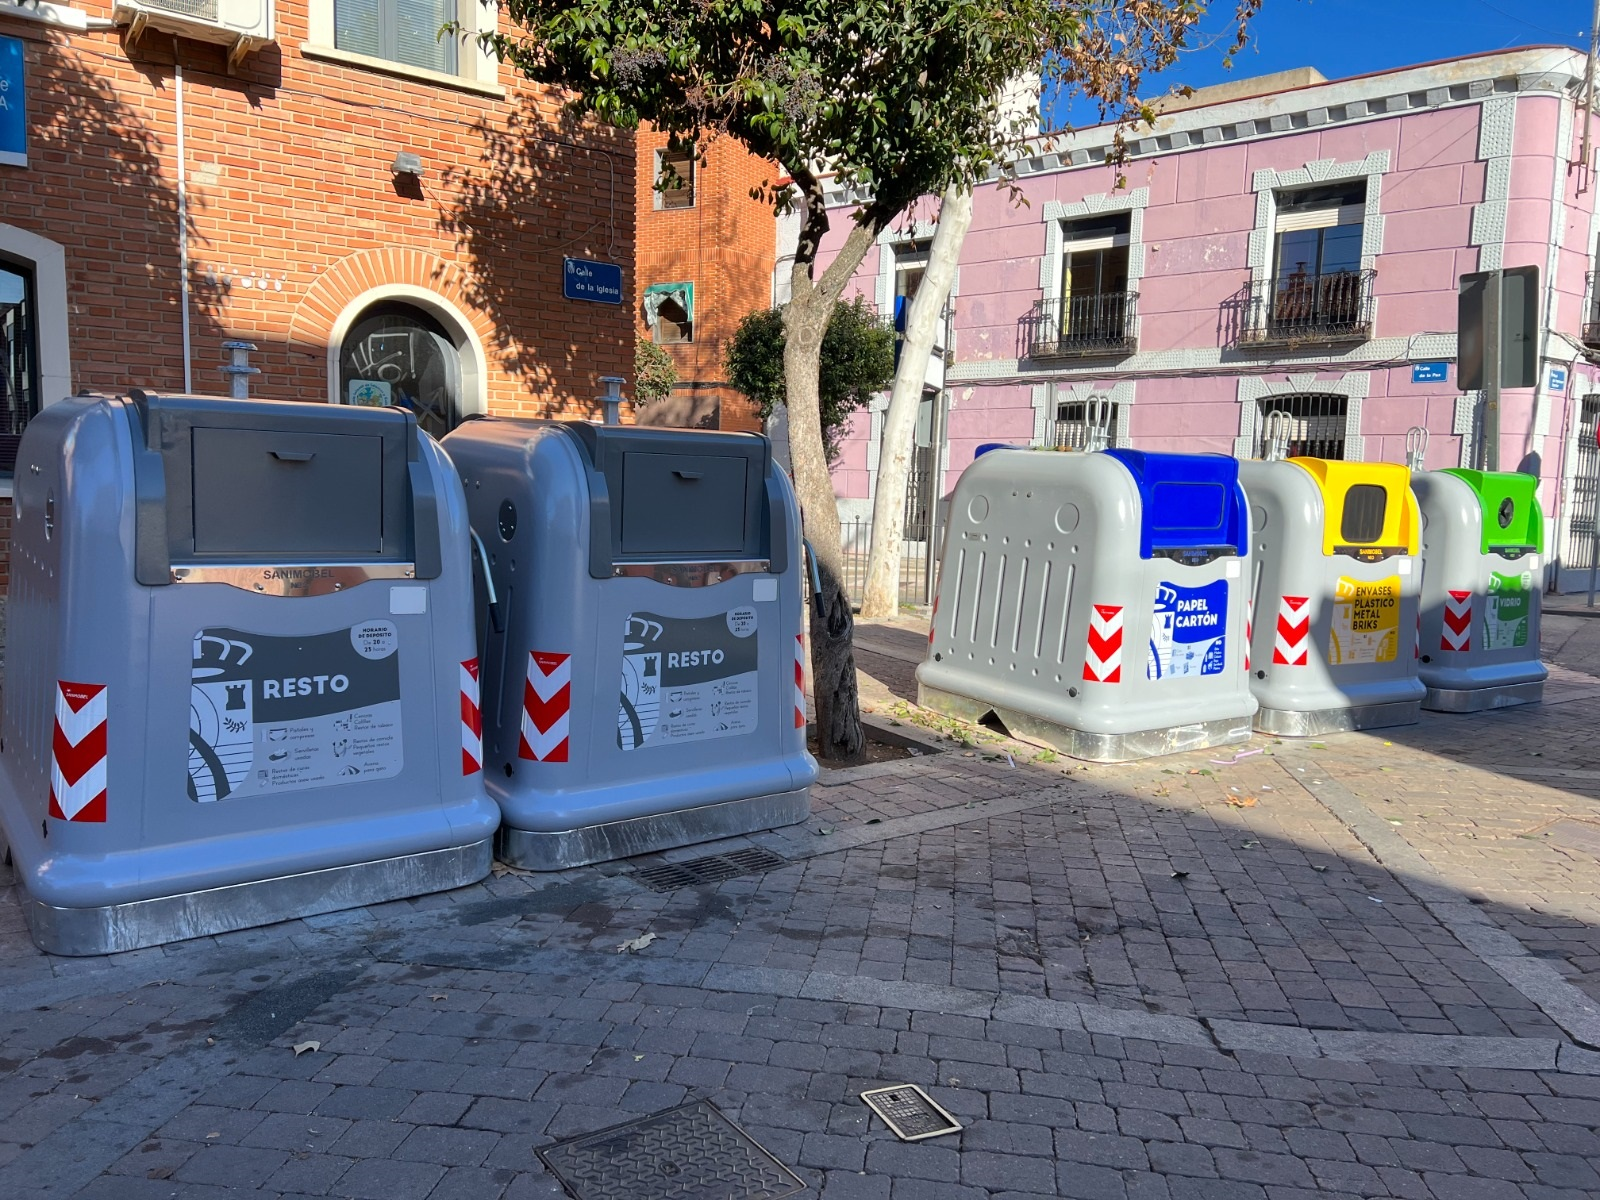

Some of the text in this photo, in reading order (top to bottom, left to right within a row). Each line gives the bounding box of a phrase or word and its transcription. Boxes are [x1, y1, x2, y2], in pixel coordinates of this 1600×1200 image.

[576, 267, 593, 277] Calle
[596, 285, 619, 295] Iglesia
[264, 569, 335, 579] SANIMOBEL
[1356, 586, 1392, 597] ENVASES
[1177, 598, 1208, 612] PAPEL
[1500, 597, 1521, 607] VIDRIO
[1354, 609, 1380, 619] METAL
[1175, 611, 1218, 628] CARTÓN
[1353, 620, 1378, 630] BRIKS
[668, 648, 725, 669] RESTO
[263, 674, 349, 700] RESTO
